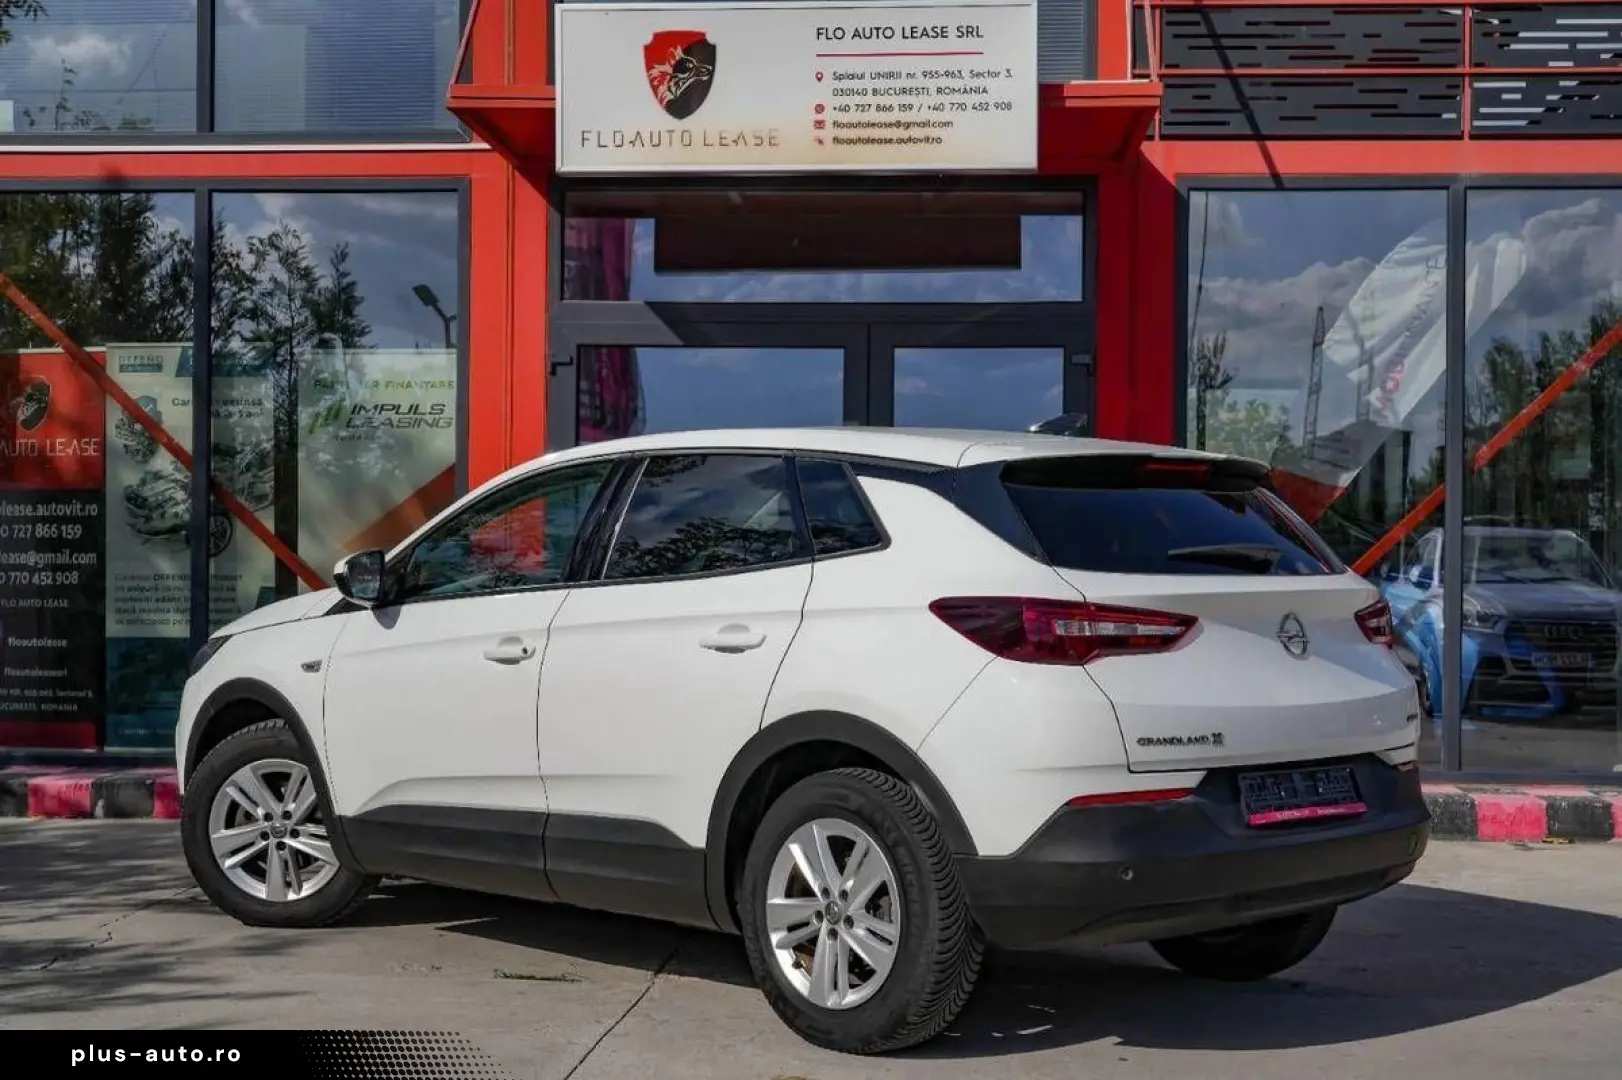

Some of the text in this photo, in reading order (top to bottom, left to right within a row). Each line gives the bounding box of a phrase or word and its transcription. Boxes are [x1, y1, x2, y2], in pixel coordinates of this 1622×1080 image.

[816, 25, 984, 41] FLO AUTO LEASE SRL
[832, 71, 866, 82] Splaiul
[870, 71, 903, 81] UNIRII
[969, 69, 1001, 80] Sector
[832, 88, 868, 97] 030140
[832, 104, 851, 113] +40
[855, 103, 872, 113] 727
[875, 103, 894, 112] 866
[898, 103, 915, 112] 159
[927, 102, 945, 112] +40
[949, 102, 967, 111] 770
[971, 102, 990, 111] 452
[993, 101, 1012, 111] 908
[832, 119, 954, 131] floautolease@gmail.com
[832, 136, 943, 146] floautolease.autovit.ro
[350, 403, 446, 416] IMPULS
[345, 417, 454, 429] LEASING
[0, 499, 98, 516] lease.autovit.ro
[12, 523, 32, 539] 727
[35, 523, 58, 538] 866
[61, 524, 82, 539] 159
[0, 548, 97, 568] ease@gmail.com
[8, 571, 29, 585] 770
[32, 571, 52, 585] 452
[55, 570, 79, 585] 908
[1136, 735, 1210, 747] GRANDLAND
